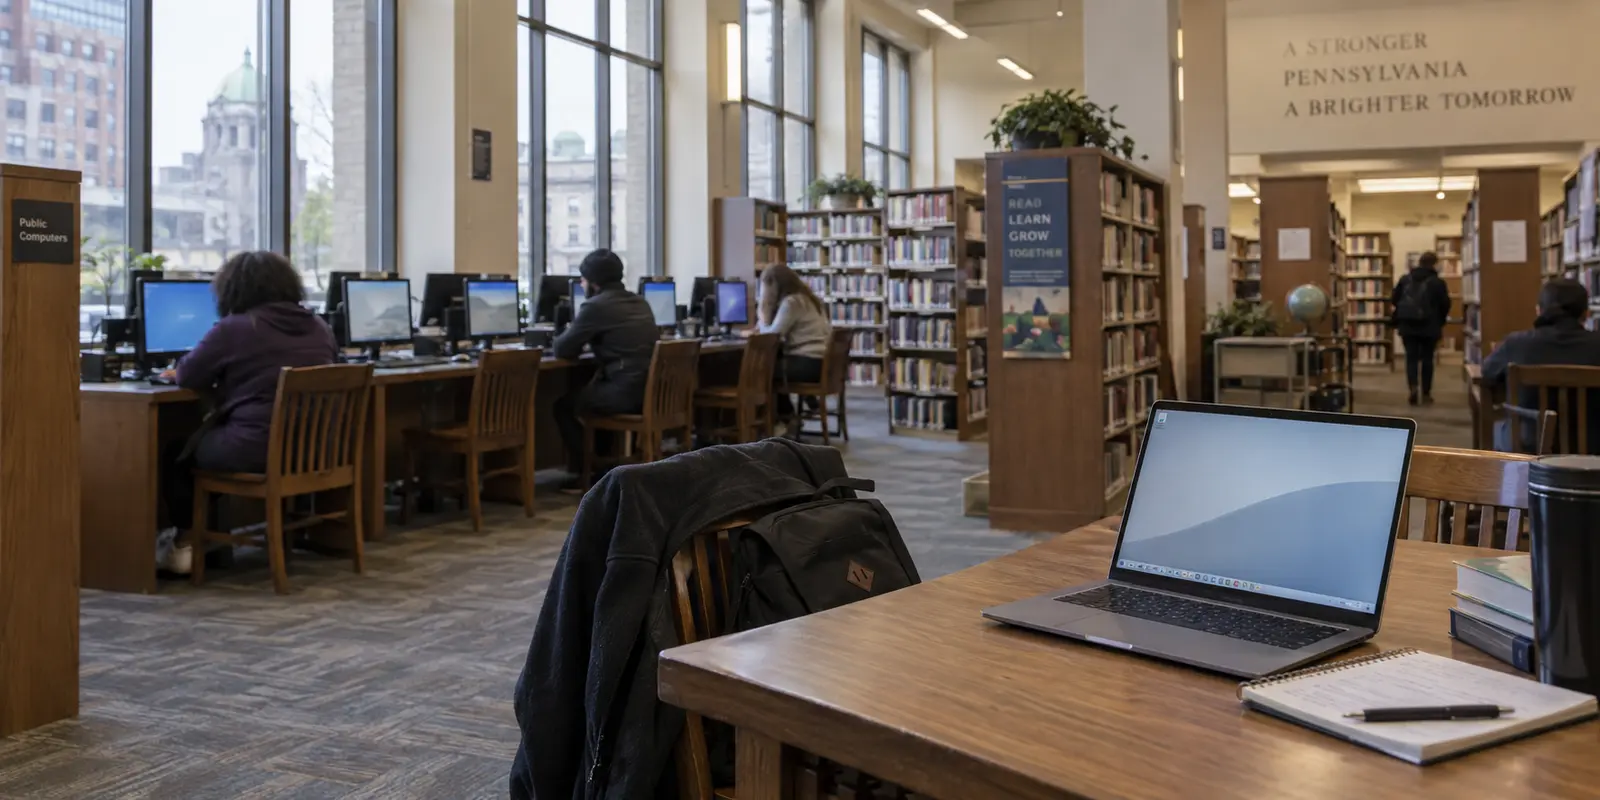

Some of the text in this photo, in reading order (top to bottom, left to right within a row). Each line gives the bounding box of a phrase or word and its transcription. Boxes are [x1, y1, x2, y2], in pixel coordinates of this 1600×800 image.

[1283, 32, 1428, 58] A STRONGER
[1284, 61, 1468, 87] PENNSYLVANIA
[1284, 86, 1576, 118] A BRIGHTER TOMORROW
[1009, 198, 1042, 209] READ
[20, 217, 47, 228] Public
[1008, 214, 1051, 225] LEARN
[20, 231, 68, 243] Computers
[1009, 230, 1049, 241] GROW
[1009, 248, 1063, 258] TOGETHER
